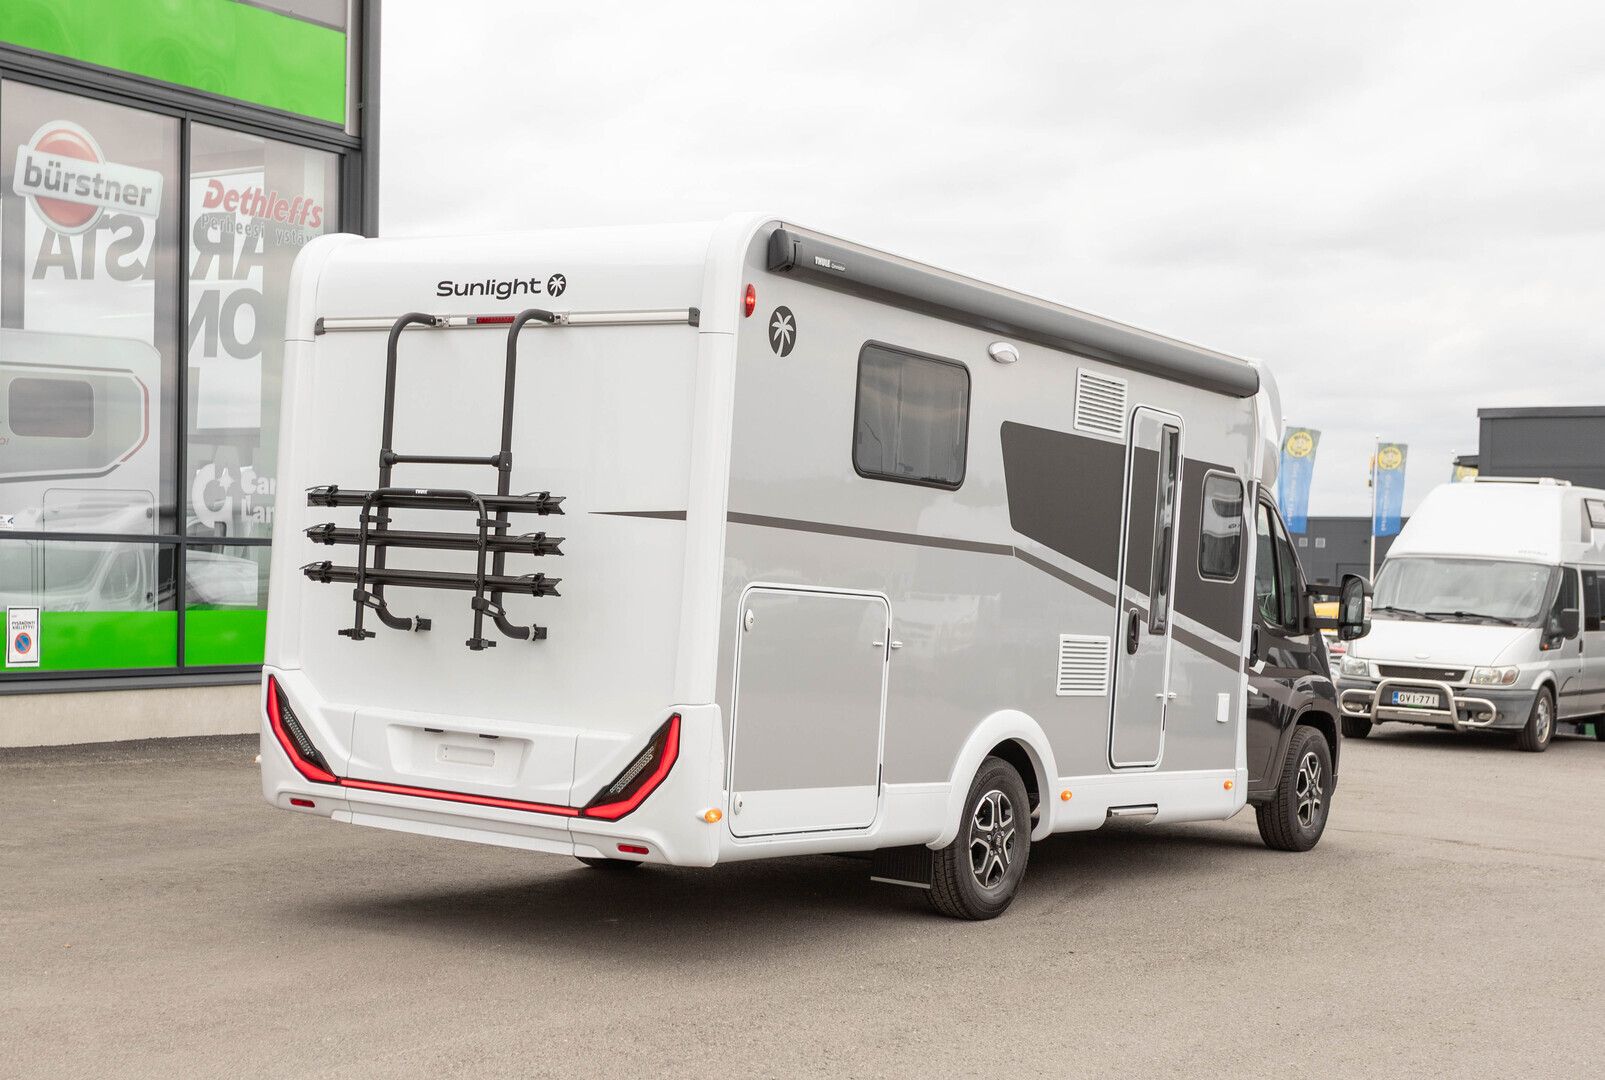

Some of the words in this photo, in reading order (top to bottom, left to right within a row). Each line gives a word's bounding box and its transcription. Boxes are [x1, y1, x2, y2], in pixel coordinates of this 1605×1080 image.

[23, 156, 152, 207] bürstner
[202, 178, 323, 229] Dethleffs
[200, 213, 265, 239] Perheesi
[437, 277, 541, 300] Sunlight
